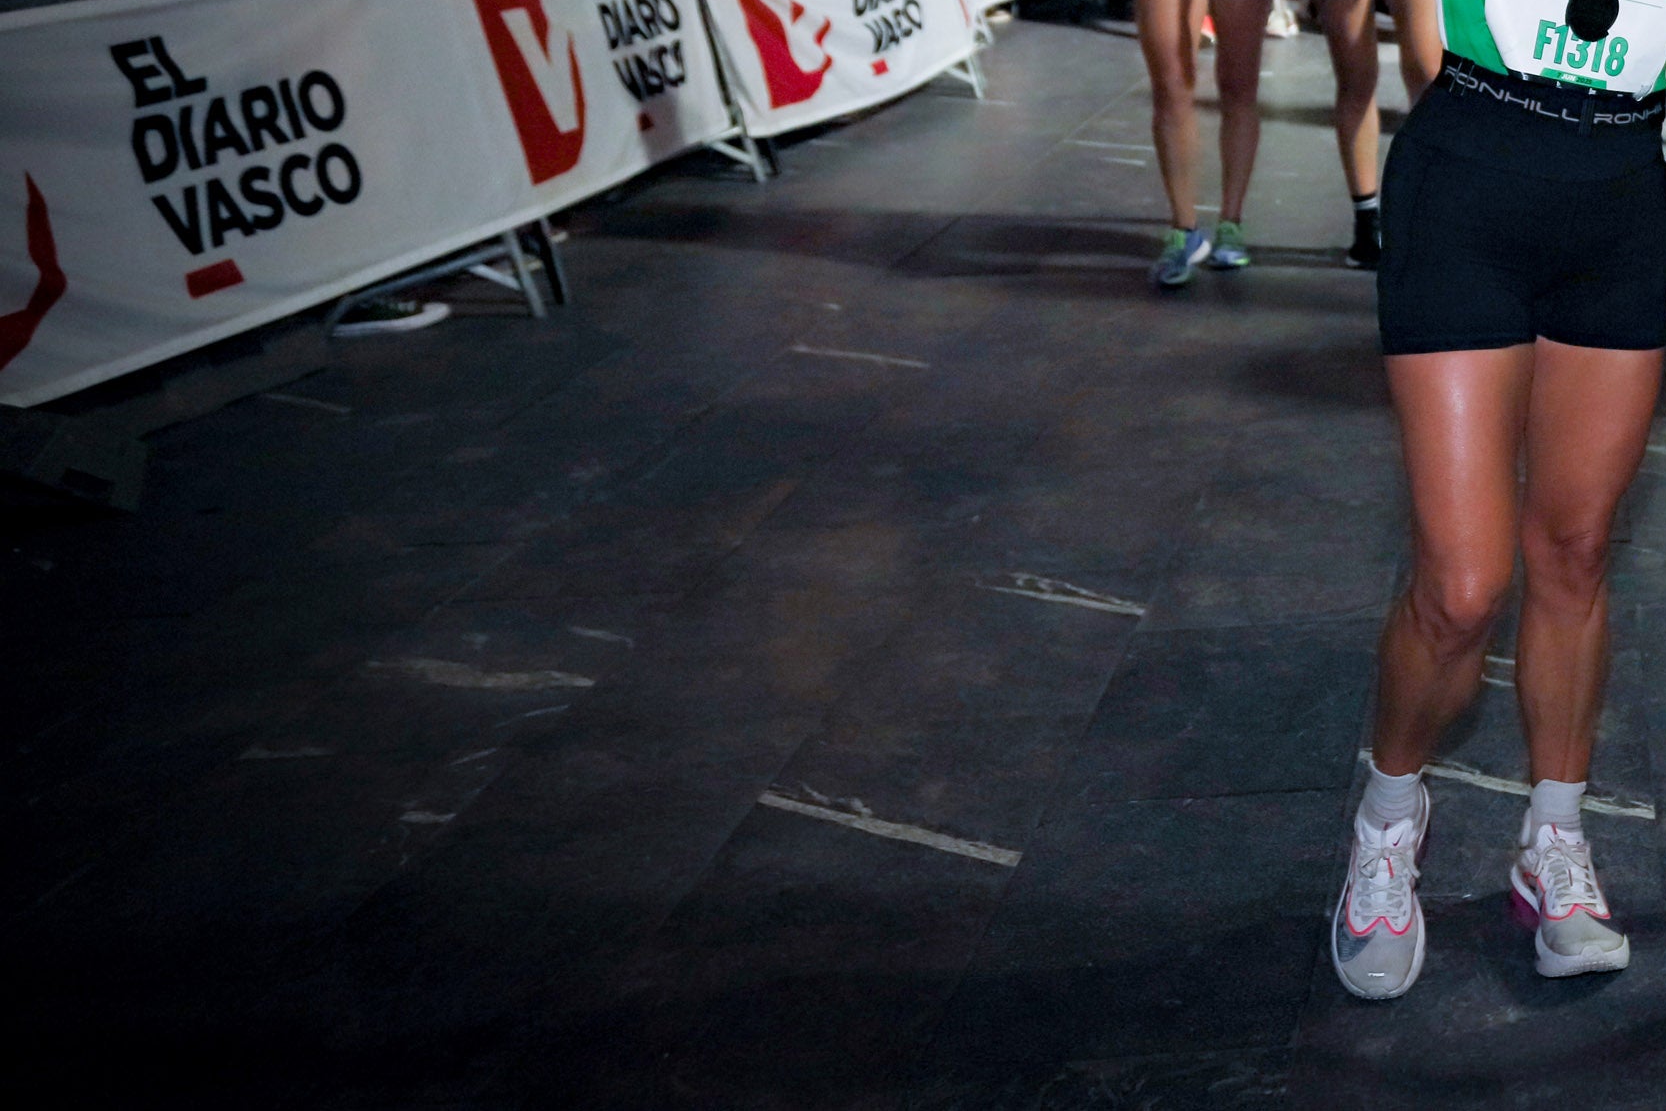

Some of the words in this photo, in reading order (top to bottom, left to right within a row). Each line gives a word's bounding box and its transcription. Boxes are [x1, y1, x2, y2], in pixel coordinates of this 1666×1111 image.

[110, 36, 206, 108] EL
[1533, 19, 1629, 77] F1318
[1561, 73, 1576, 82] JUN
[1444, 64, 1580, 122] RONHILL
[131, 70, 346, 184] DIARIO
[152, 143, 363, 255] VASCO
